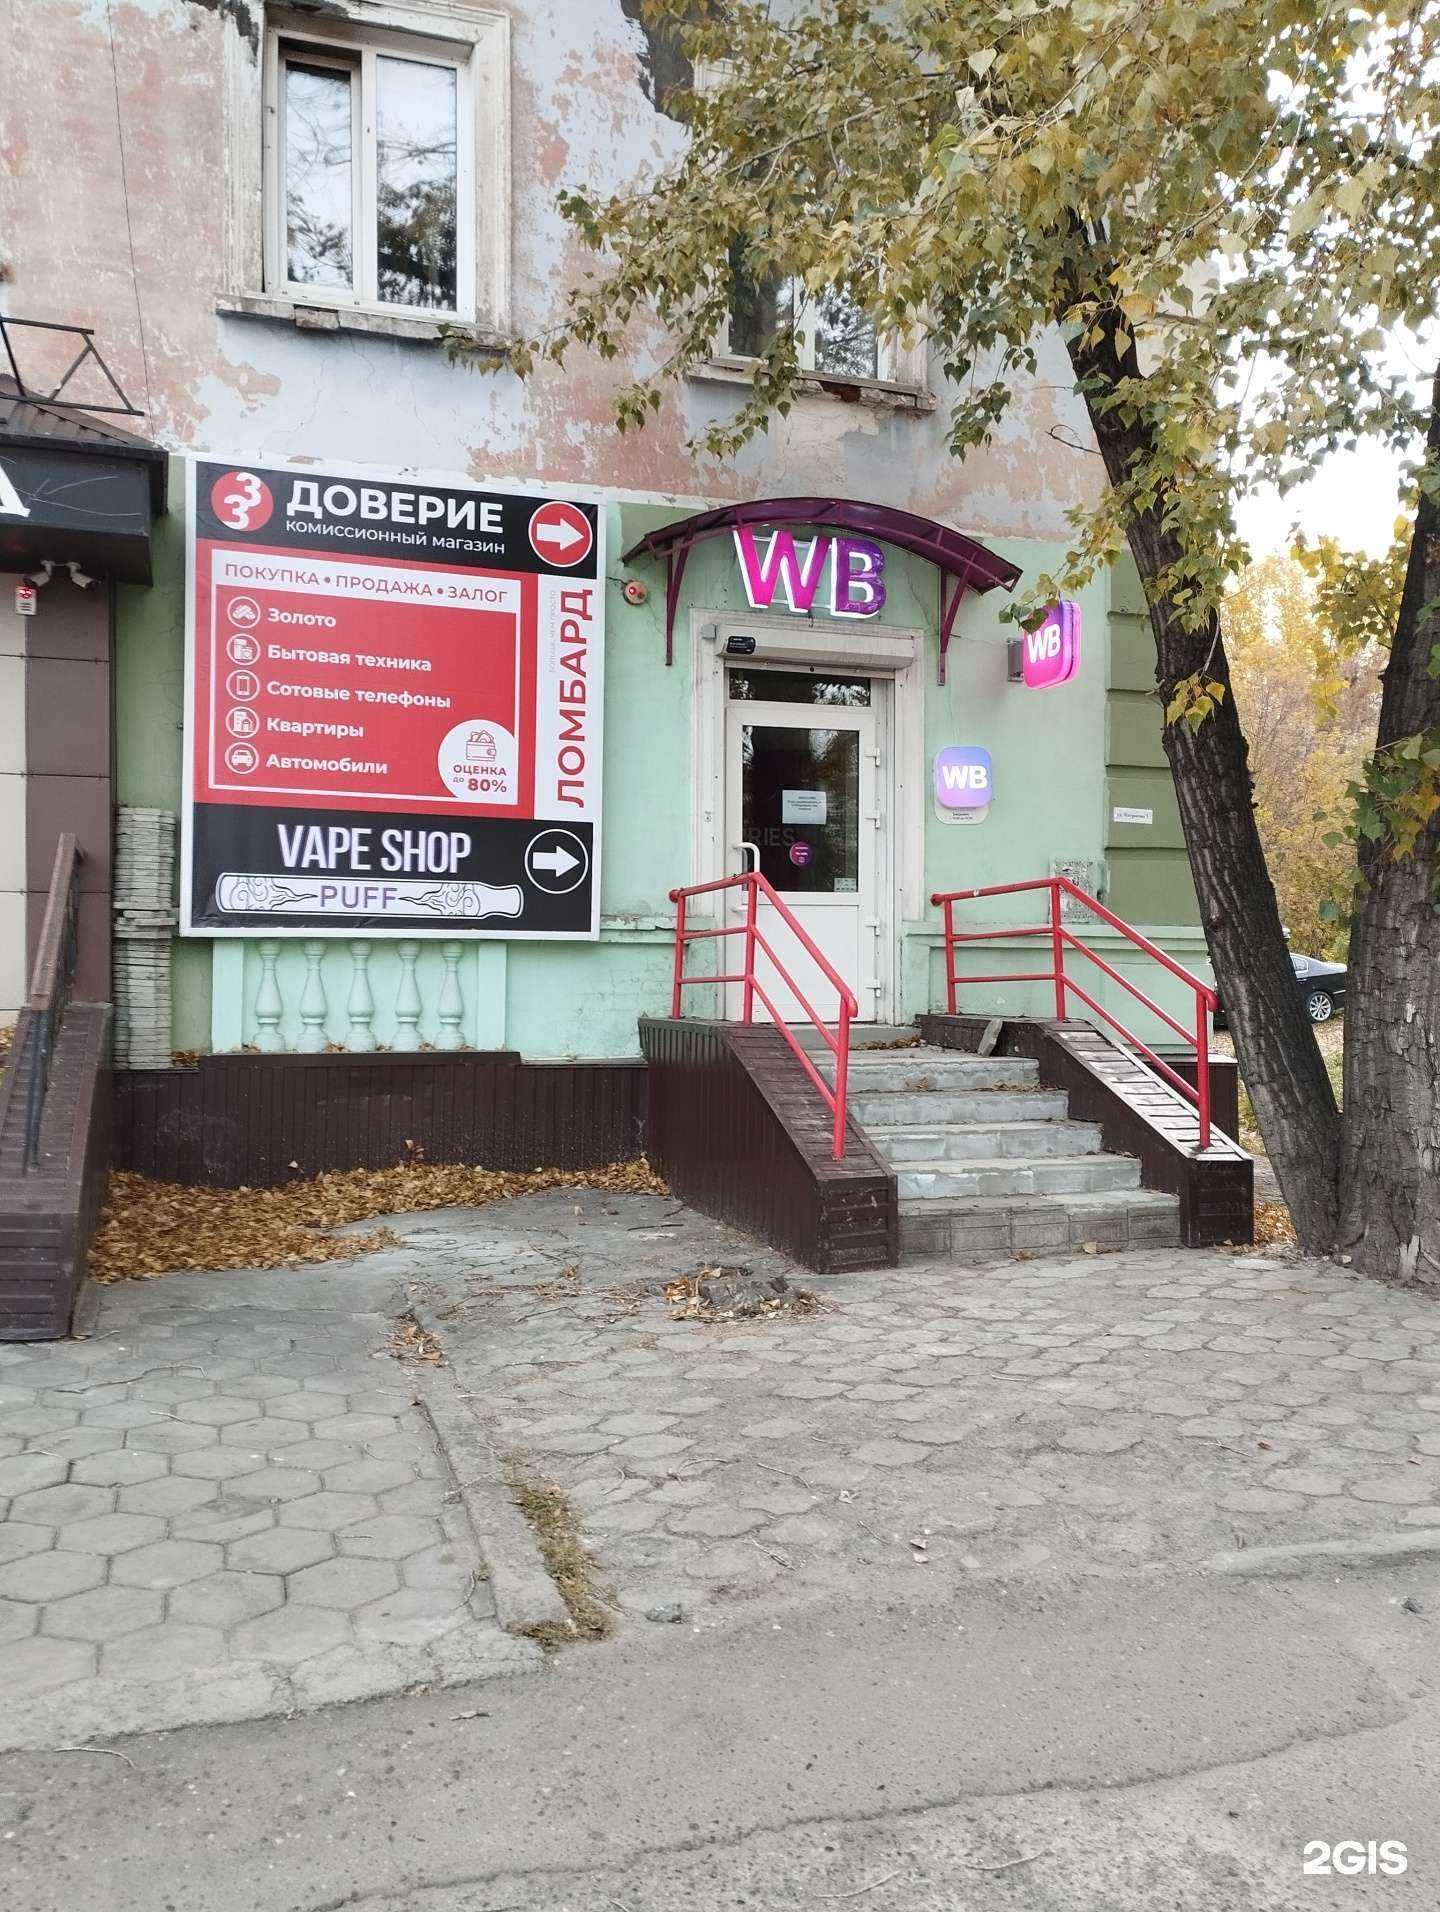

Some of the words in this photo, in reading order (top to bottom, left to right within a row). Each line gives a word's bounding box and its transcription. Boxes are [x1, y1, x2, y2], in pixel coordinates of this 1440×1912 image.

[286, 480, 504, 533] ДОВЕРИЕ
[286, 520, 427, 546] комиссионный
[432, 536, 505, 555] магазин
[225, 563, 320, 586] ПОКУПКА
[336, 575, 433, 597] ПРОДАЖА
[447, 586, 508, 604] ЗАЛОГ
[733, 527, 886, 619] WB
[267, 608, 336, 628] Золото
[1027, 623, 1061, 664] WB
[267, 644, 350, 665] Бытовая
[355, 653, 432, 672] техника
[266, 681, 350, 701] Сотовые
[355, 690, 451, 709] телефоны
[557, 589, 593, 809] ЛОМБАРД
[266, 717, 364, 739] Квартиры
[265, 754, 388, 775] Автомобили
[453, 764, 507, 776] ОЦЕНКА
[942, 765, 988, 790] WB
[467, 778, 507, 793] 80%
[277, 824, 373, 870] VAPE
[380, 828, 472, 874] SHOP
[320, 885, 398, 909] PUFF
